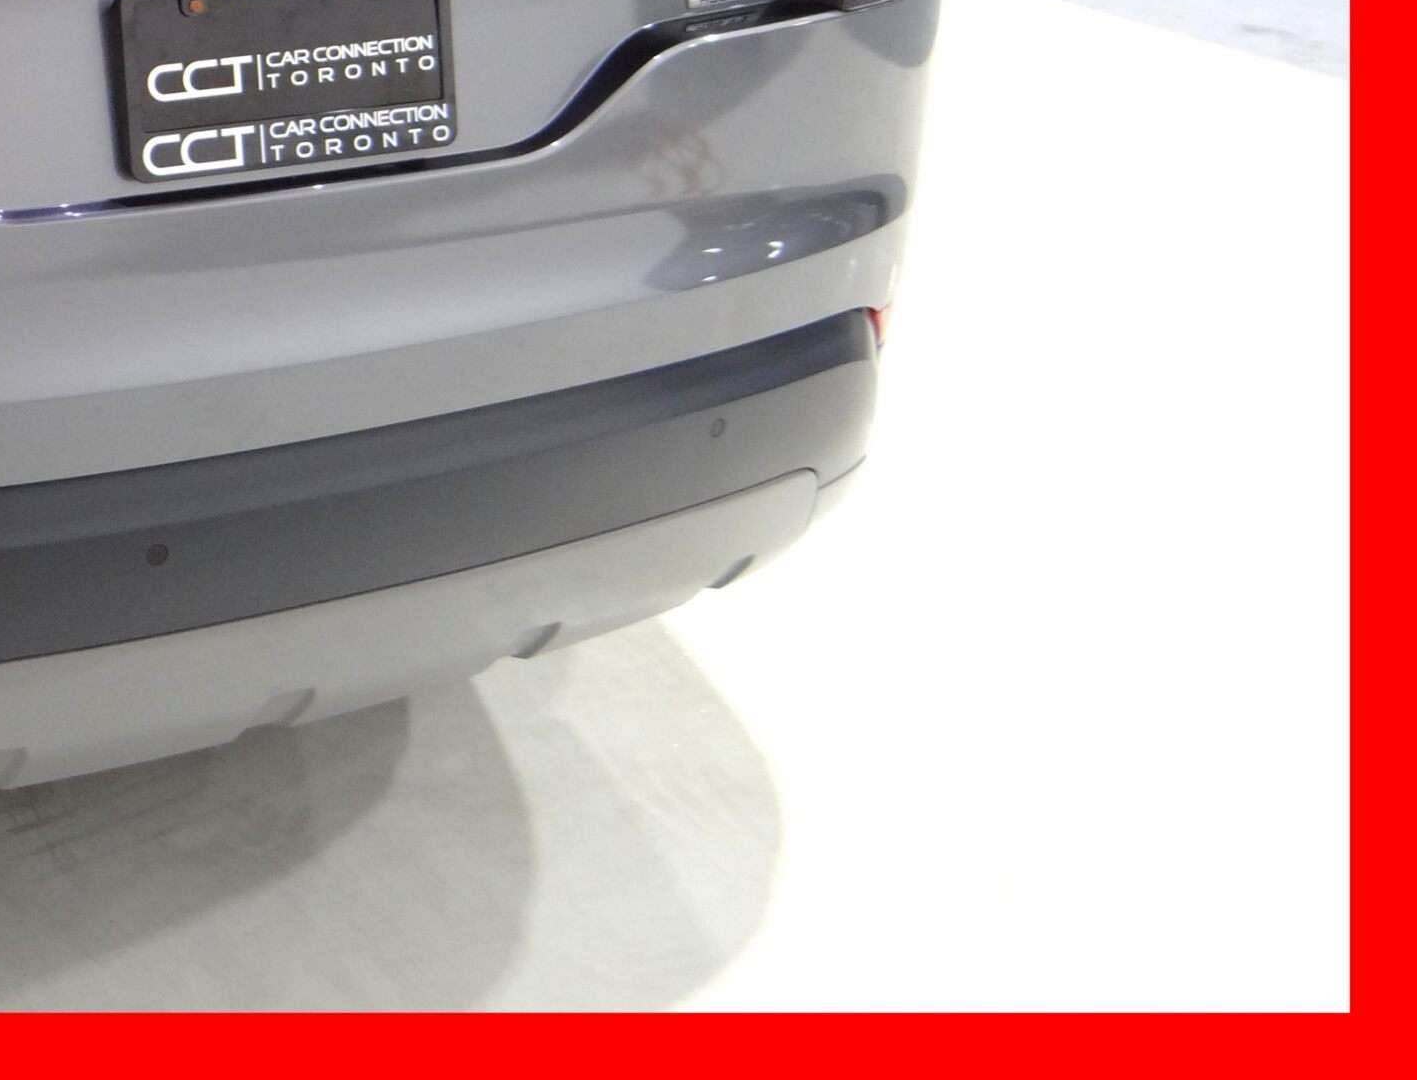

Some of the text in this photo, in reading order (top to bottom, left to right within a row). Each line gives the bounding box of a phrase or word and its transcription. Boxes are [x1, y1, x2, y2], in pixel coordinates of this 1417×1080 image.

[266, 34, 434, 68] CAR CONNECTION
[147, 55, 253, 102] CCT
[266, 54, 436, 87] TORONTO
[269, 103, 448, 139] CAR CONNECTION
[142, 125, 255, 176] CCT
[270, 124, 451, 162] TORONTO
